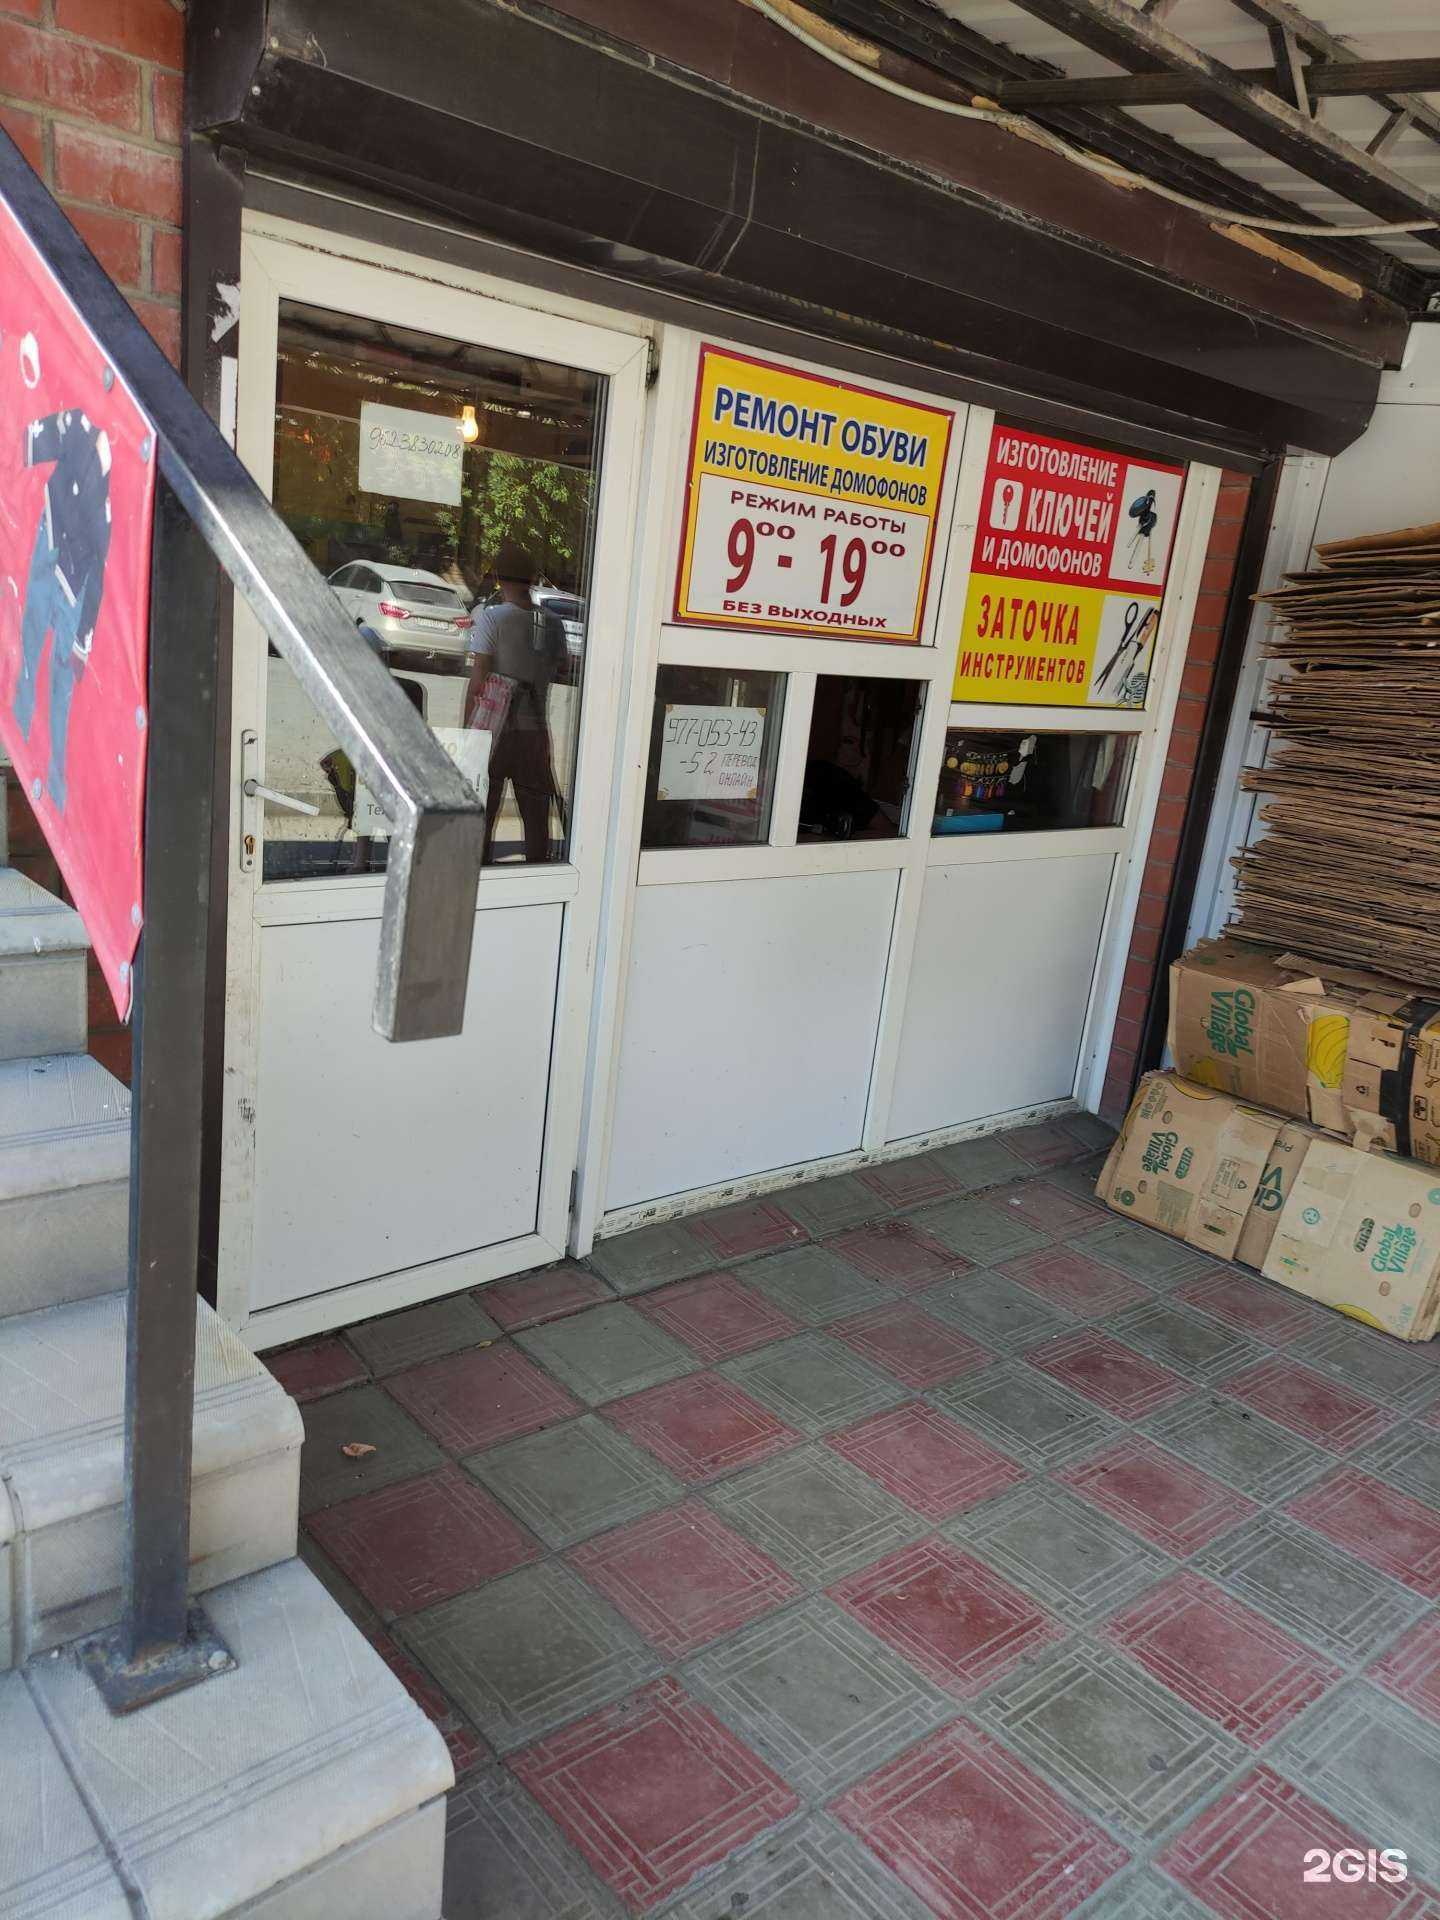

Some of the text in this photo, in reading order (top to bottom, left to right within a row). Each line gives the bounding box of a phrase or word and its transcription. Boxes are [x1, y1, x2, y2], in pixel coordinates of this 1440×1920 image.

[714, 387, 928, 468] РЕМОНТ ОБУВИ
[704, 440, 928, 506] ИЗГОТОВЛЕНИЕ ДОМОФОНОВ
[996, 437, 1119, 488] ИЗГОТОВЛЕНИЕ
[730, 490, 906, 534] РЕЖИМ РАБОТЫ
[1026, 487, 1115, 544] КЛЮЧЕЙ
[981, 536, 1103, 578] И ДОМОФОНОВ
[722, 599, 888, 628] БЕЗ ВЫХОДНЫХ
[977, 594, 1081, 645] ЗАТОЧКА
[960, 652, 1086, 684] ИНСТРУМЕНТОВ
[1207, 991, 1234, 1054] Village
[1234, 989, 1256, 1056] Global
[1142, 1132, 1166, 1172] Village
[1160, 1131, 1179, 1172] Global
[1371, 1225, 1396, 1272] Global
[1387, 1226, 1416, 1273] Village
